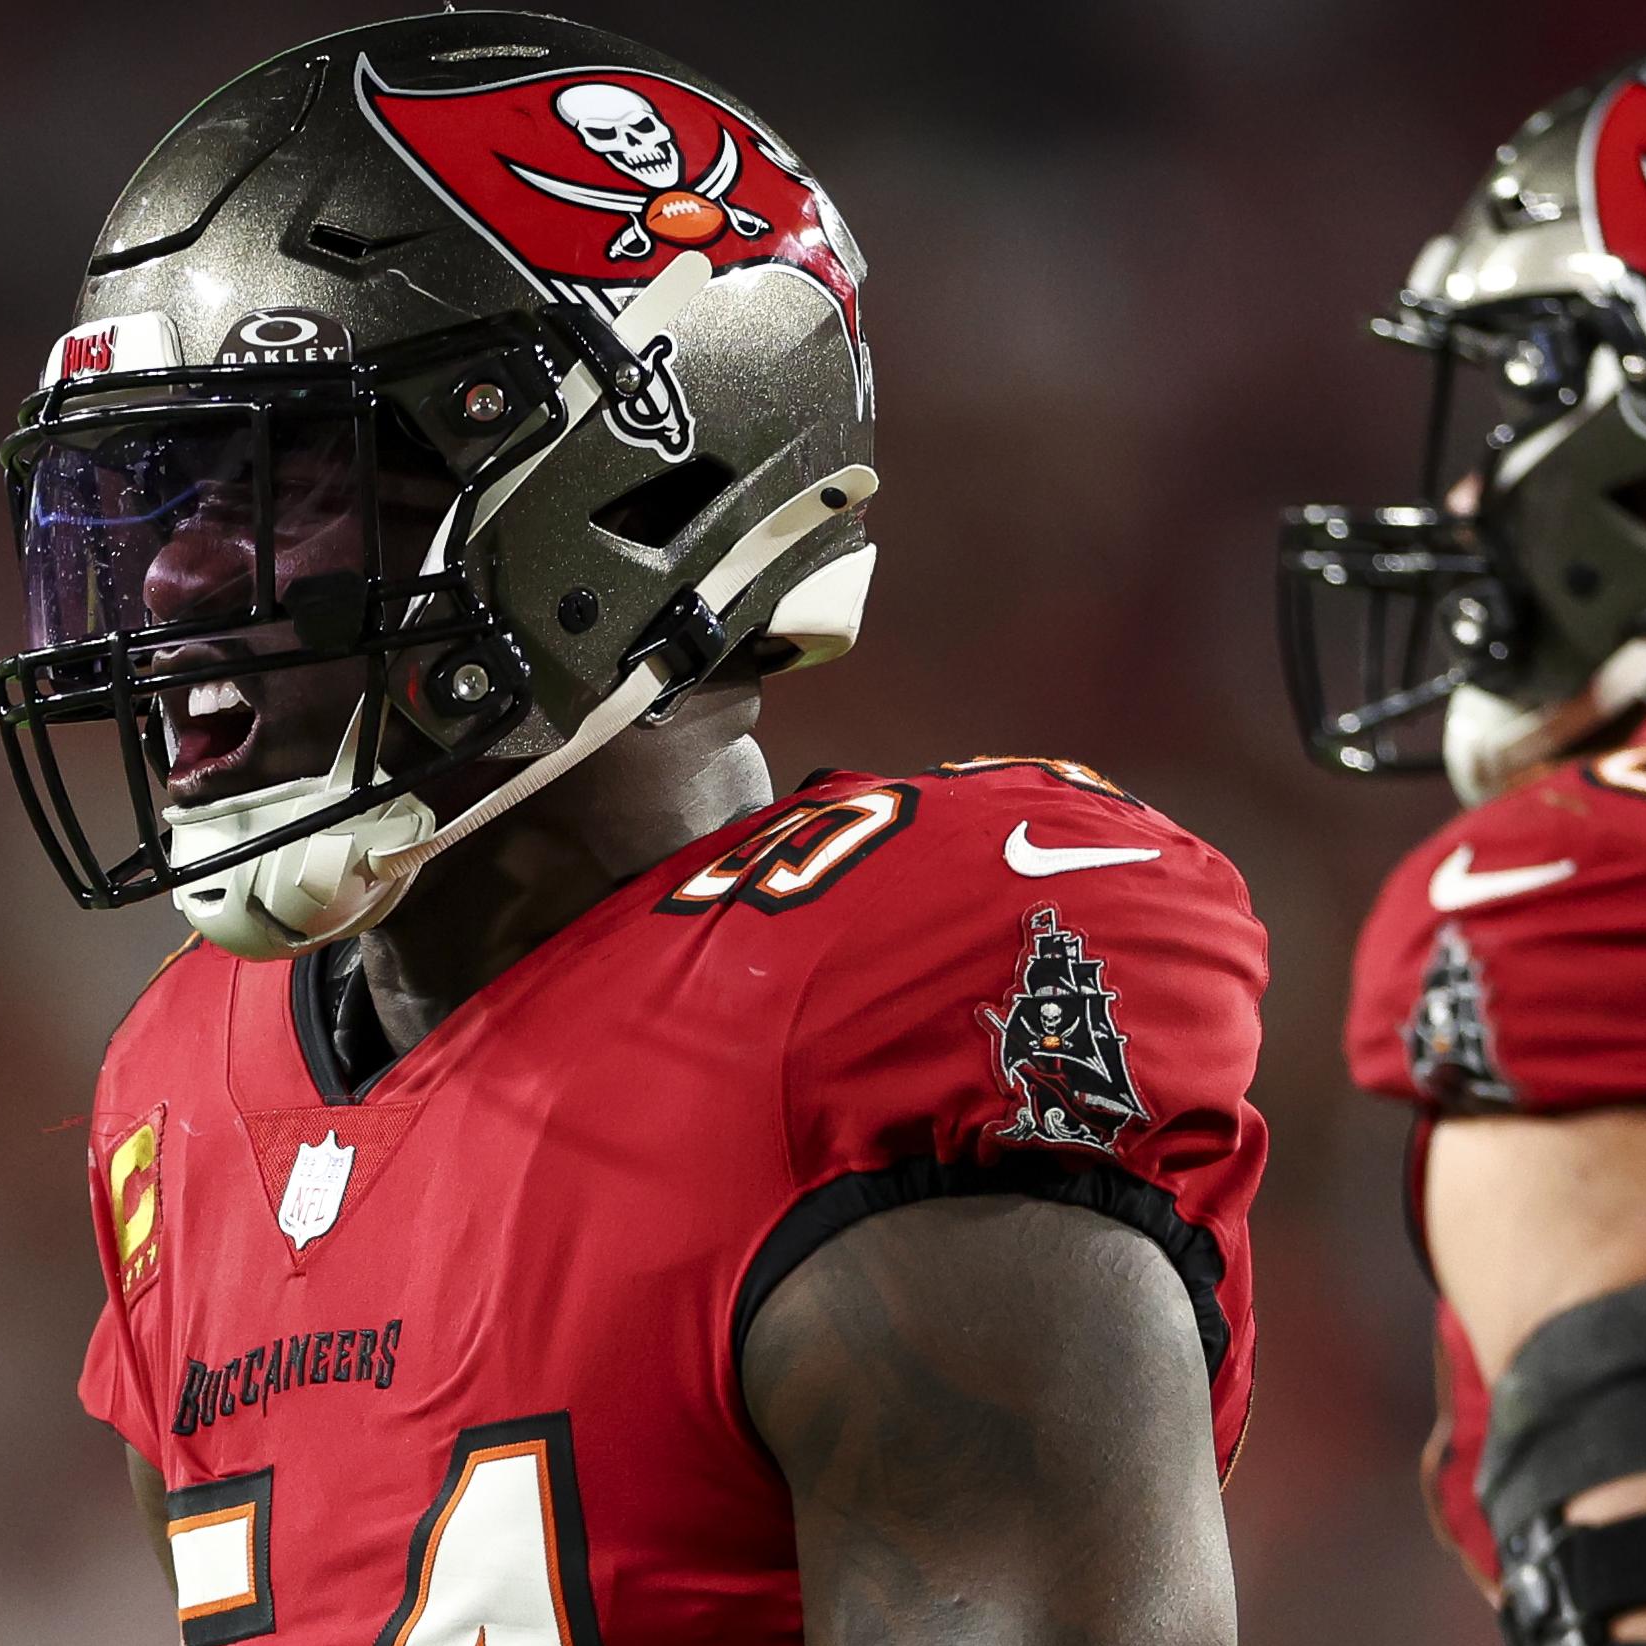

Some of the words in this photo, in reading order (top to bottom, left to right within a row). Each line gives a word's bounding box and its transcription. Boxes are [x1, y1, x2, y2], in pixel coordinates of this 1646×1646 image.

[222, 347, 339, 365] OAKLEY
[286, 1186, 328, 1226] NFL
[171, 1319, 403, 1437] BUCCANEERS
